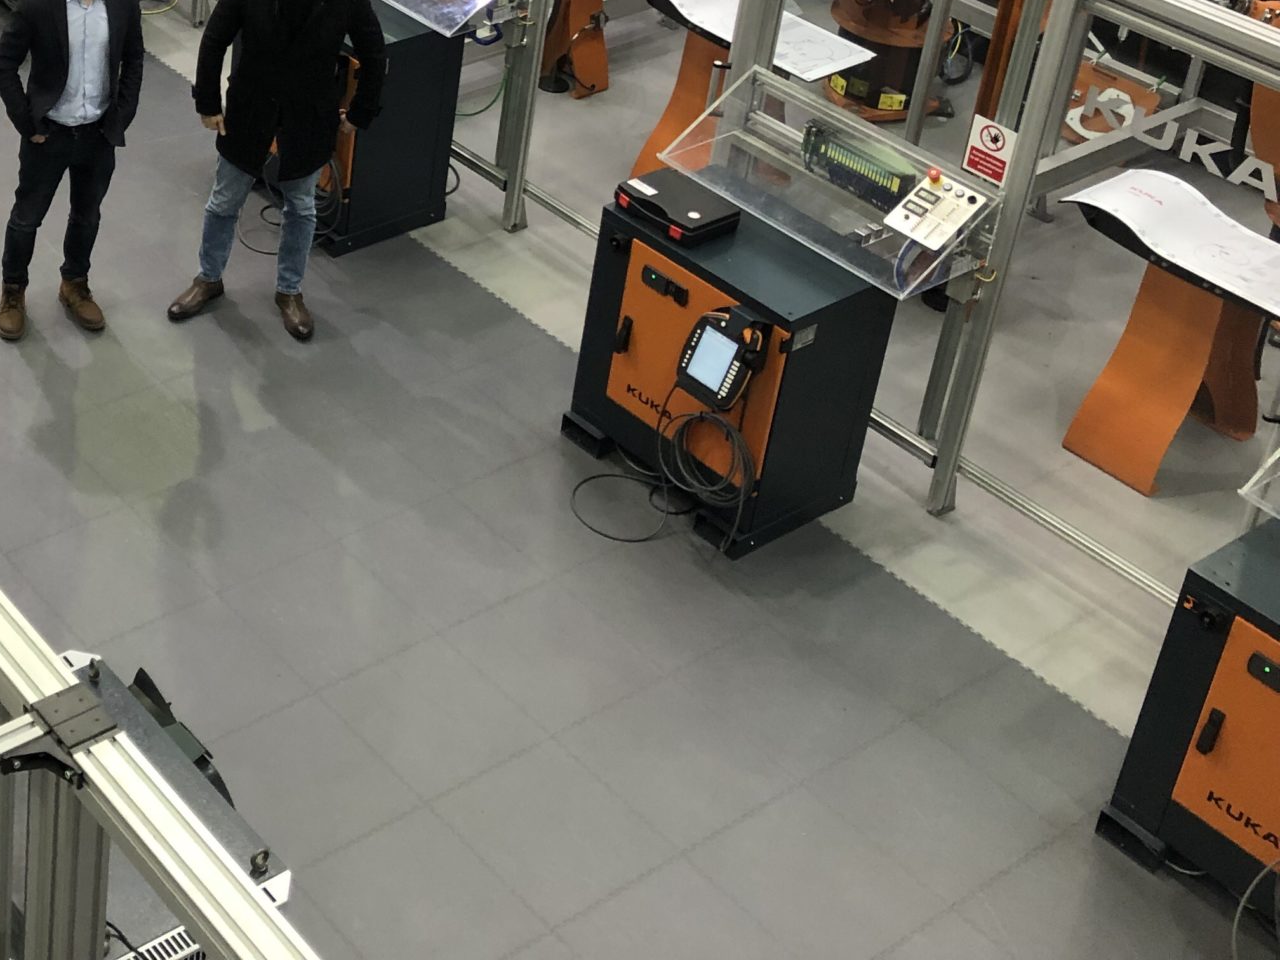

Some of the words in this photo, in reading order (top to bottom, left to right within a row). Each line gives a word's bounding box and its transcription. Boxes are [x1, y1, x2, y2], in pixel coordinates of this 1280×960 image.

[1083, 84, 1278, 203] KUKA
[626, 383, 672, 420] KUKA
[1207, 790, 1280, 849] KUKA
